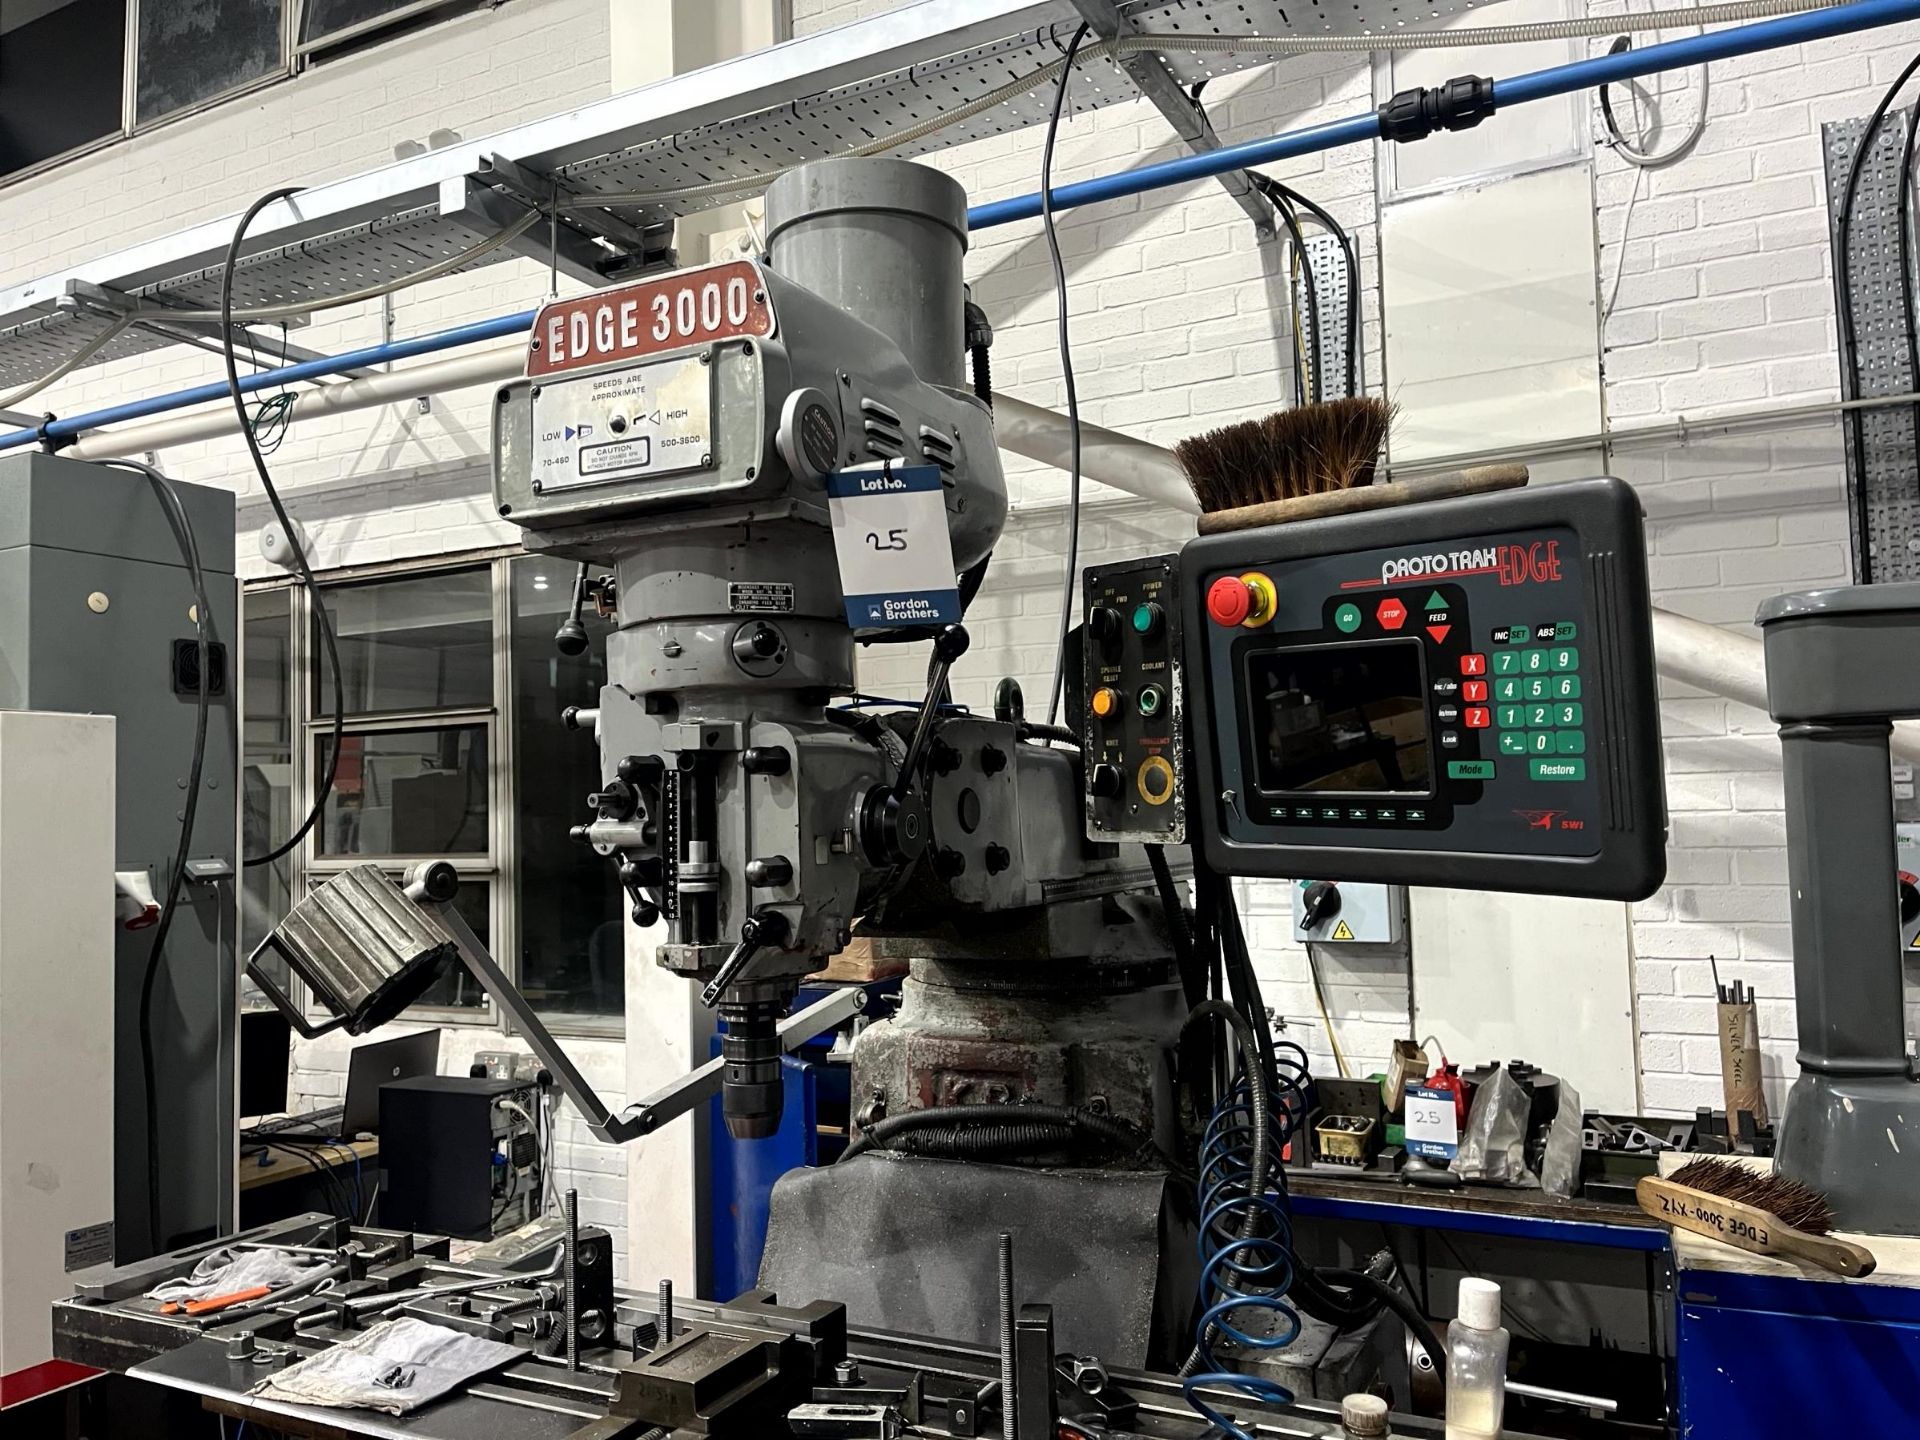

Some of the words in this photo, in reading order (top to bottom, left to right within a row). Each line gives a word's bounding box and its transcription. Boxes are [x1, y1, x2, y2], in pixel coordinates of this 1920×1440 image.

[548, 300, 638, 364] EDGE
[651, 277, 748, 342] 3000
[593, 378, 623, 390] SPEEDS
[626, 374, 642, 384] ARE
[591, 386, 646, 402] APPROXIMATE
[666, 409, 688, 420] HIGH
[542, 431, 561, 442] LOW
[660, 435, 701, 448] 500-3600
[596, 444, 632, 456] CAUTION
[860, 478, 883, 491] Lot
[865, 528, 908, 551] 25
[1498, 540, 1562, 586] EDGE
[1104, 588, 1115, 596] OFF
[1142, 581, 1162, 590] POWER
[1116, 595, 1128, 604] FWD
[1148, 591, 1157, 599] ON
[883, 599, 929, 610] Gordon
[885, 607, 939, 620] Brothers
[1343, 614, 1353, 622] GO
[1383, 610, 1400, 619] STOP
[1429, 613, 1447, 622] FEED
[1494, 630, 1509, 641] INC
[1510, 629, 1527, 639] SET
[1537, 627, 1555, 637] ABS
[1556, 626, 1573, 636] SET
[1141, 661, 1165, 671] COOLANT
[1468, 657, 1477, 672] X
[1501, 655, 1511, 670] 7
[1530, 653, 1540, 669] 8
[1559, 652, 1569, 667] 9
[1470, 684, 1479, 698] Y
[1504, 682, 1513, 697] 4
[1532, 681, 1542, 695] 5
[1561, 679, 1571, 694] 6
[1473, 710, 1481, 725] Z
[1507, 709, 1514, 723] 1
[1534, 708, 1544, 723] 2
[1563, 707, 1573, 722] 3
[1536, 735, 1546, 750] 0
[1458, 764, 1482, 774] Mode
[1540, 764, 1575, 775] Restore
[1561, 820, 1584, 830] SWI
[1417, 1090, 1428, 1098] Lot
[1429, 1091, 1439, 1099] No.
[1414, 1110, 1441, 1125] 25
[1422, 1148, 1448, 1156] Brothers
[1729, 1218, 1768, 1246] EDGE
